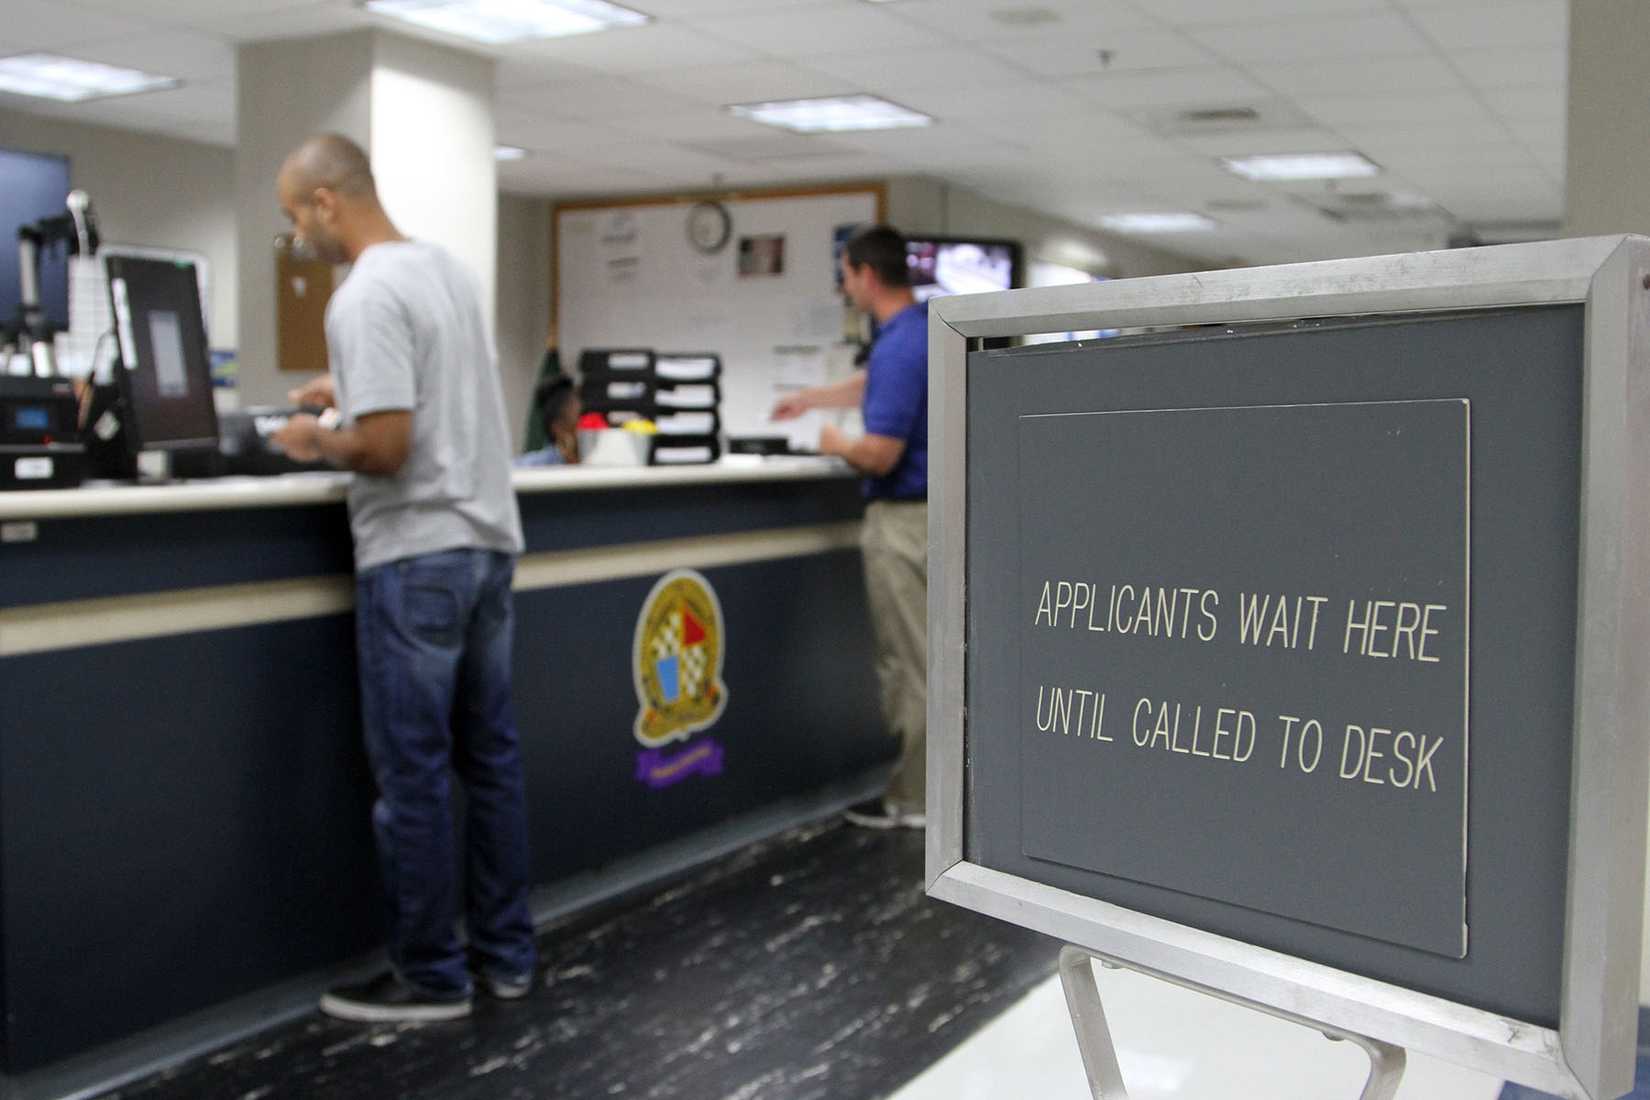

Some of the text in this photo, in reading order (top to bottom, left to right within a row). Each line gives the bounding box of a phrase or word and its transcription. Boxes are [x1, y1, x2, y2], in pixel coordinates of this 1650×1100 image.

[1035, 581, 1448, 662] APPLICANTS WAIT HERE
[1036, 685, 1444, 792] UNTIL CALLED TO DESK
